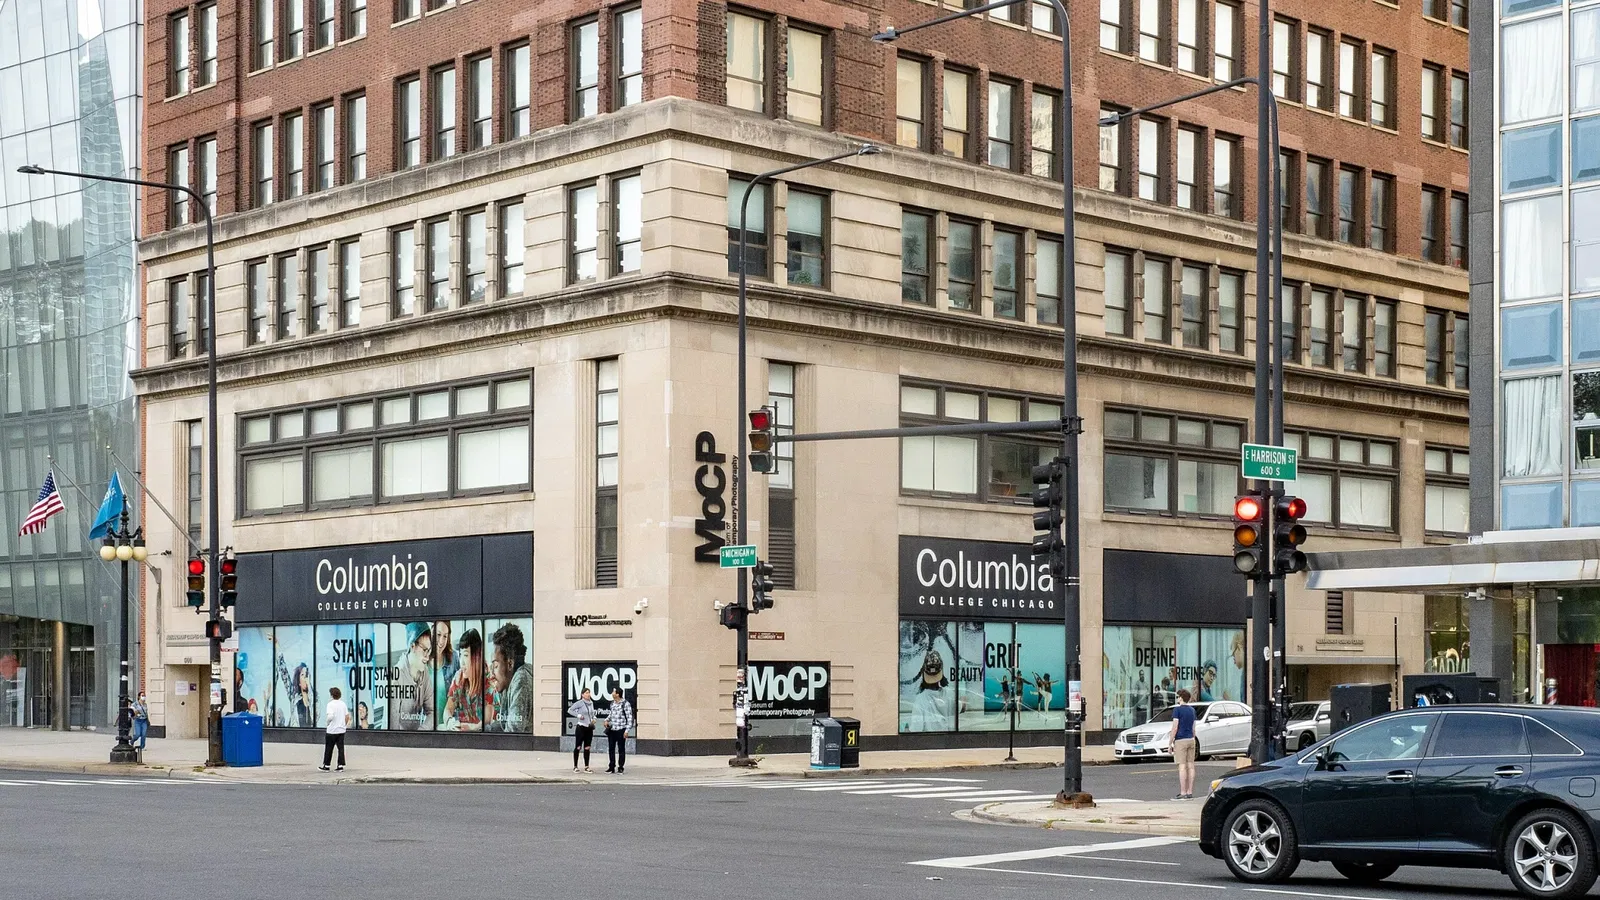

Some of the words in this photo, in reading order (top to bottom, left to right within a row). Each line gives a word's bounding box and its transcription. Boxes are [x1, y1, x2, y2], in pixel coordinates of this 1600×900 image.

[1245, 450, 1250, 460] E
[1251, 449, 1287, 465] HARRISON
[1287, 454, 1295, 464] ST
[730, 455, 739, 505] Photography
[1260, 466, 1273, 475] 600
[1275, 467, 1281, 476] S
[695, 431, 727, 562] MoCP
[725, 548, 750, 558] MICHIGAN
[316, 554, 428, 594] Columbia
[916, 548, 1054, 592] Columbia
[317, 601, 367, 611] COLLEGE
[374, 598, 428, 609] CHICAGO
[918, 595, 983, 606] COLLEGE
[992, 598, 1054, 609] CHICAGO
[564, 615, 588, 627] MoCP
[332, 639, 373, 664] STAND
[985, 642, 1022, 668] GRIT
[1136, 647, 1175, 667] DEFINE
[349, 666, 374, 691] OUT
[374, 666, 400, 680] STAND
[1175, 666, 1204, 681] REFINE
[374, 684, 415, 699] TOGETHER
[568, 667, 637, 701] MoCP
[747, 665, 828, 701] MoCP
[783, 708, 815, 717] Photography
